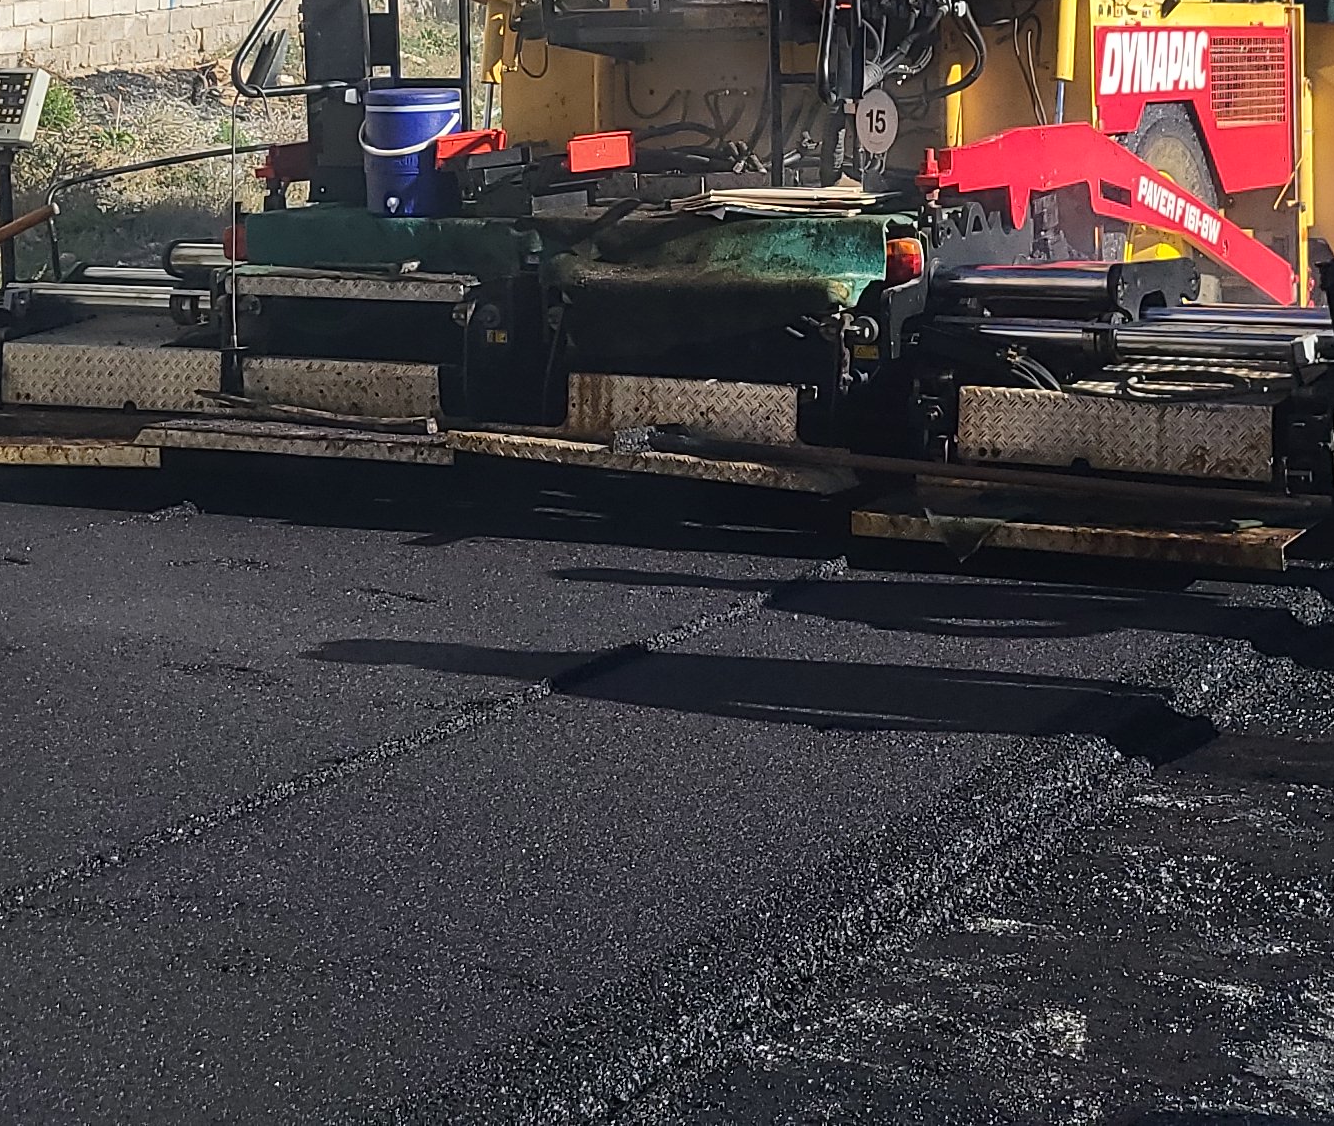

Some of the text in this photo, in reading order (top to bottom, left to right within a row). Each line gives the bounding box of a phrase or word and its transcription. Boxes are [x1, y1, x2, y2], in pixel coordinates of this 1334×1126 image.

[1100, 30, 1208, 95] DYNAPAC
[866, 109, 886, 134] 15
[1137, 175, 1176, 221] PAVER
[1174, 197, 1186, 223] F
